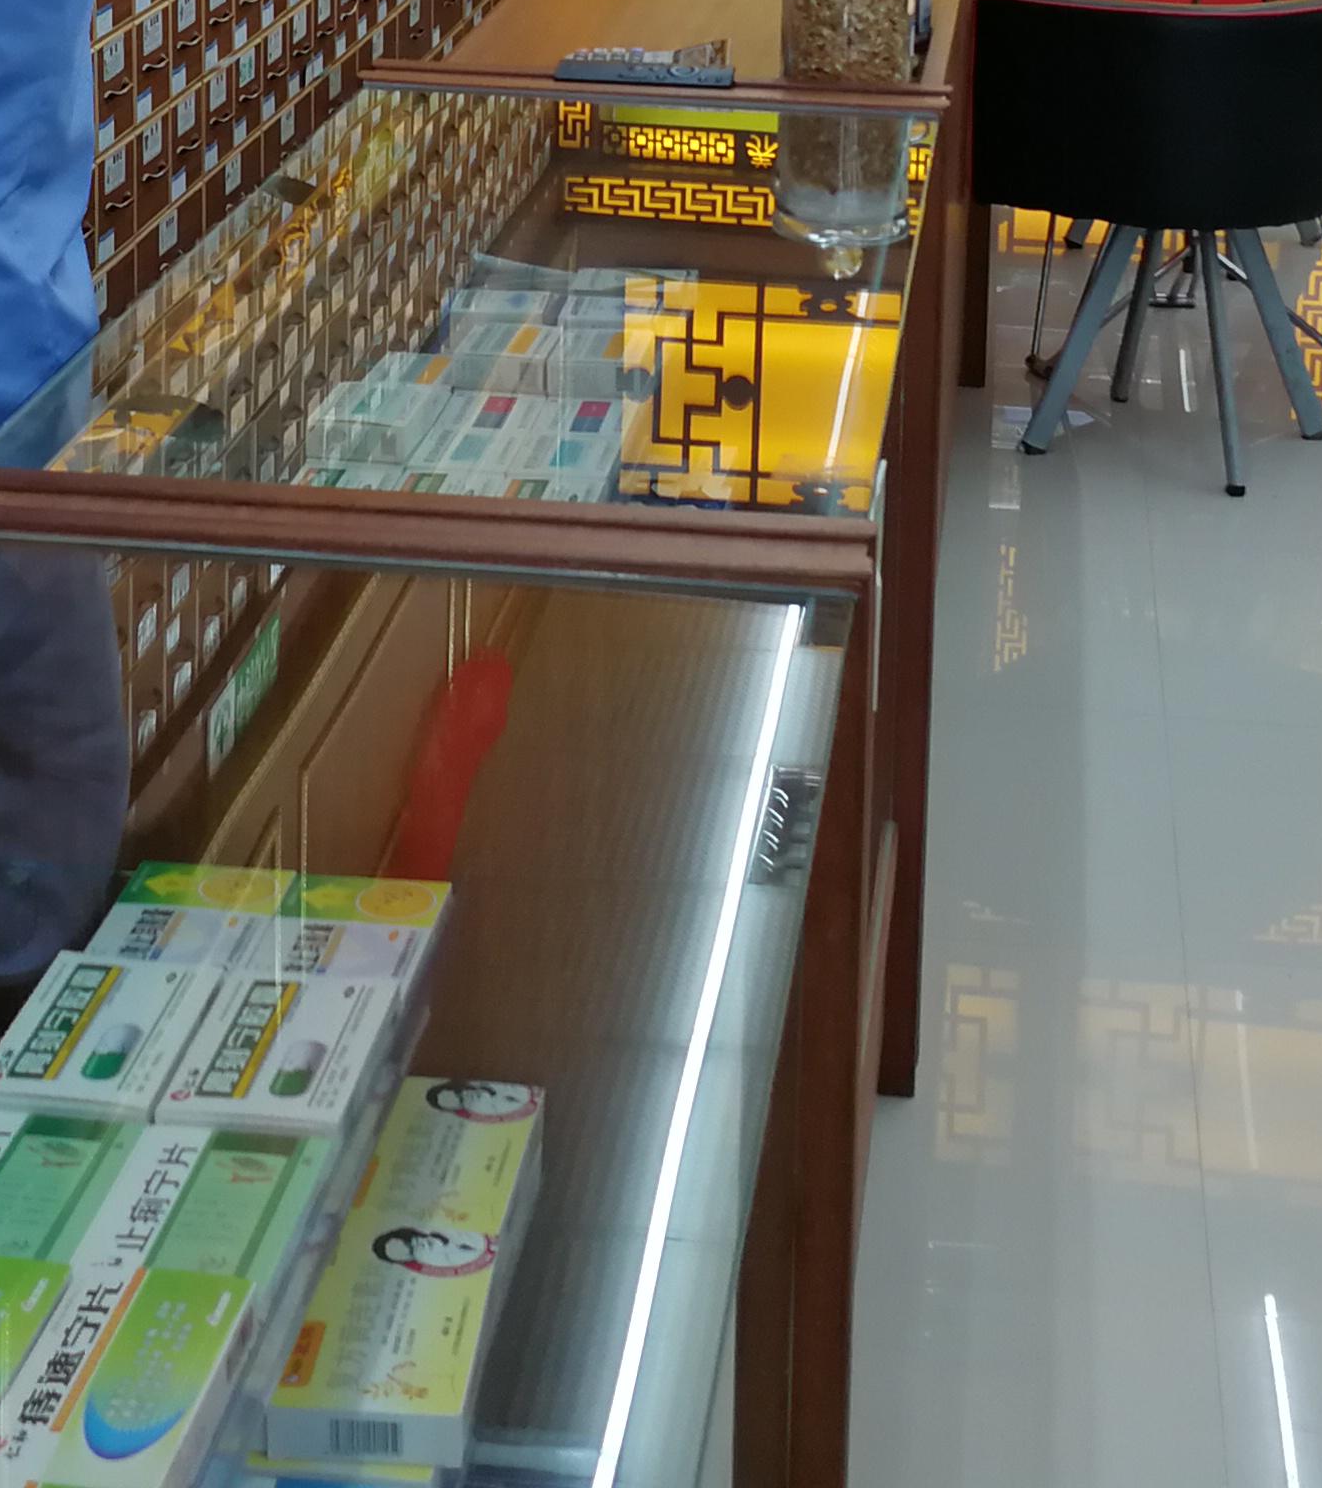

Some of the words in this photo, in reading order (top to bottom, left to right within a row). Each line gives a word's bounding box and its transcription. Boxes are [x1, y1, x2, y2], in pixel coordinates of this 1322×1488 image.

[114, 1141, 199, 1253] 止痢宁片
[19, 1279, 126, 1427] 痔速宁片
